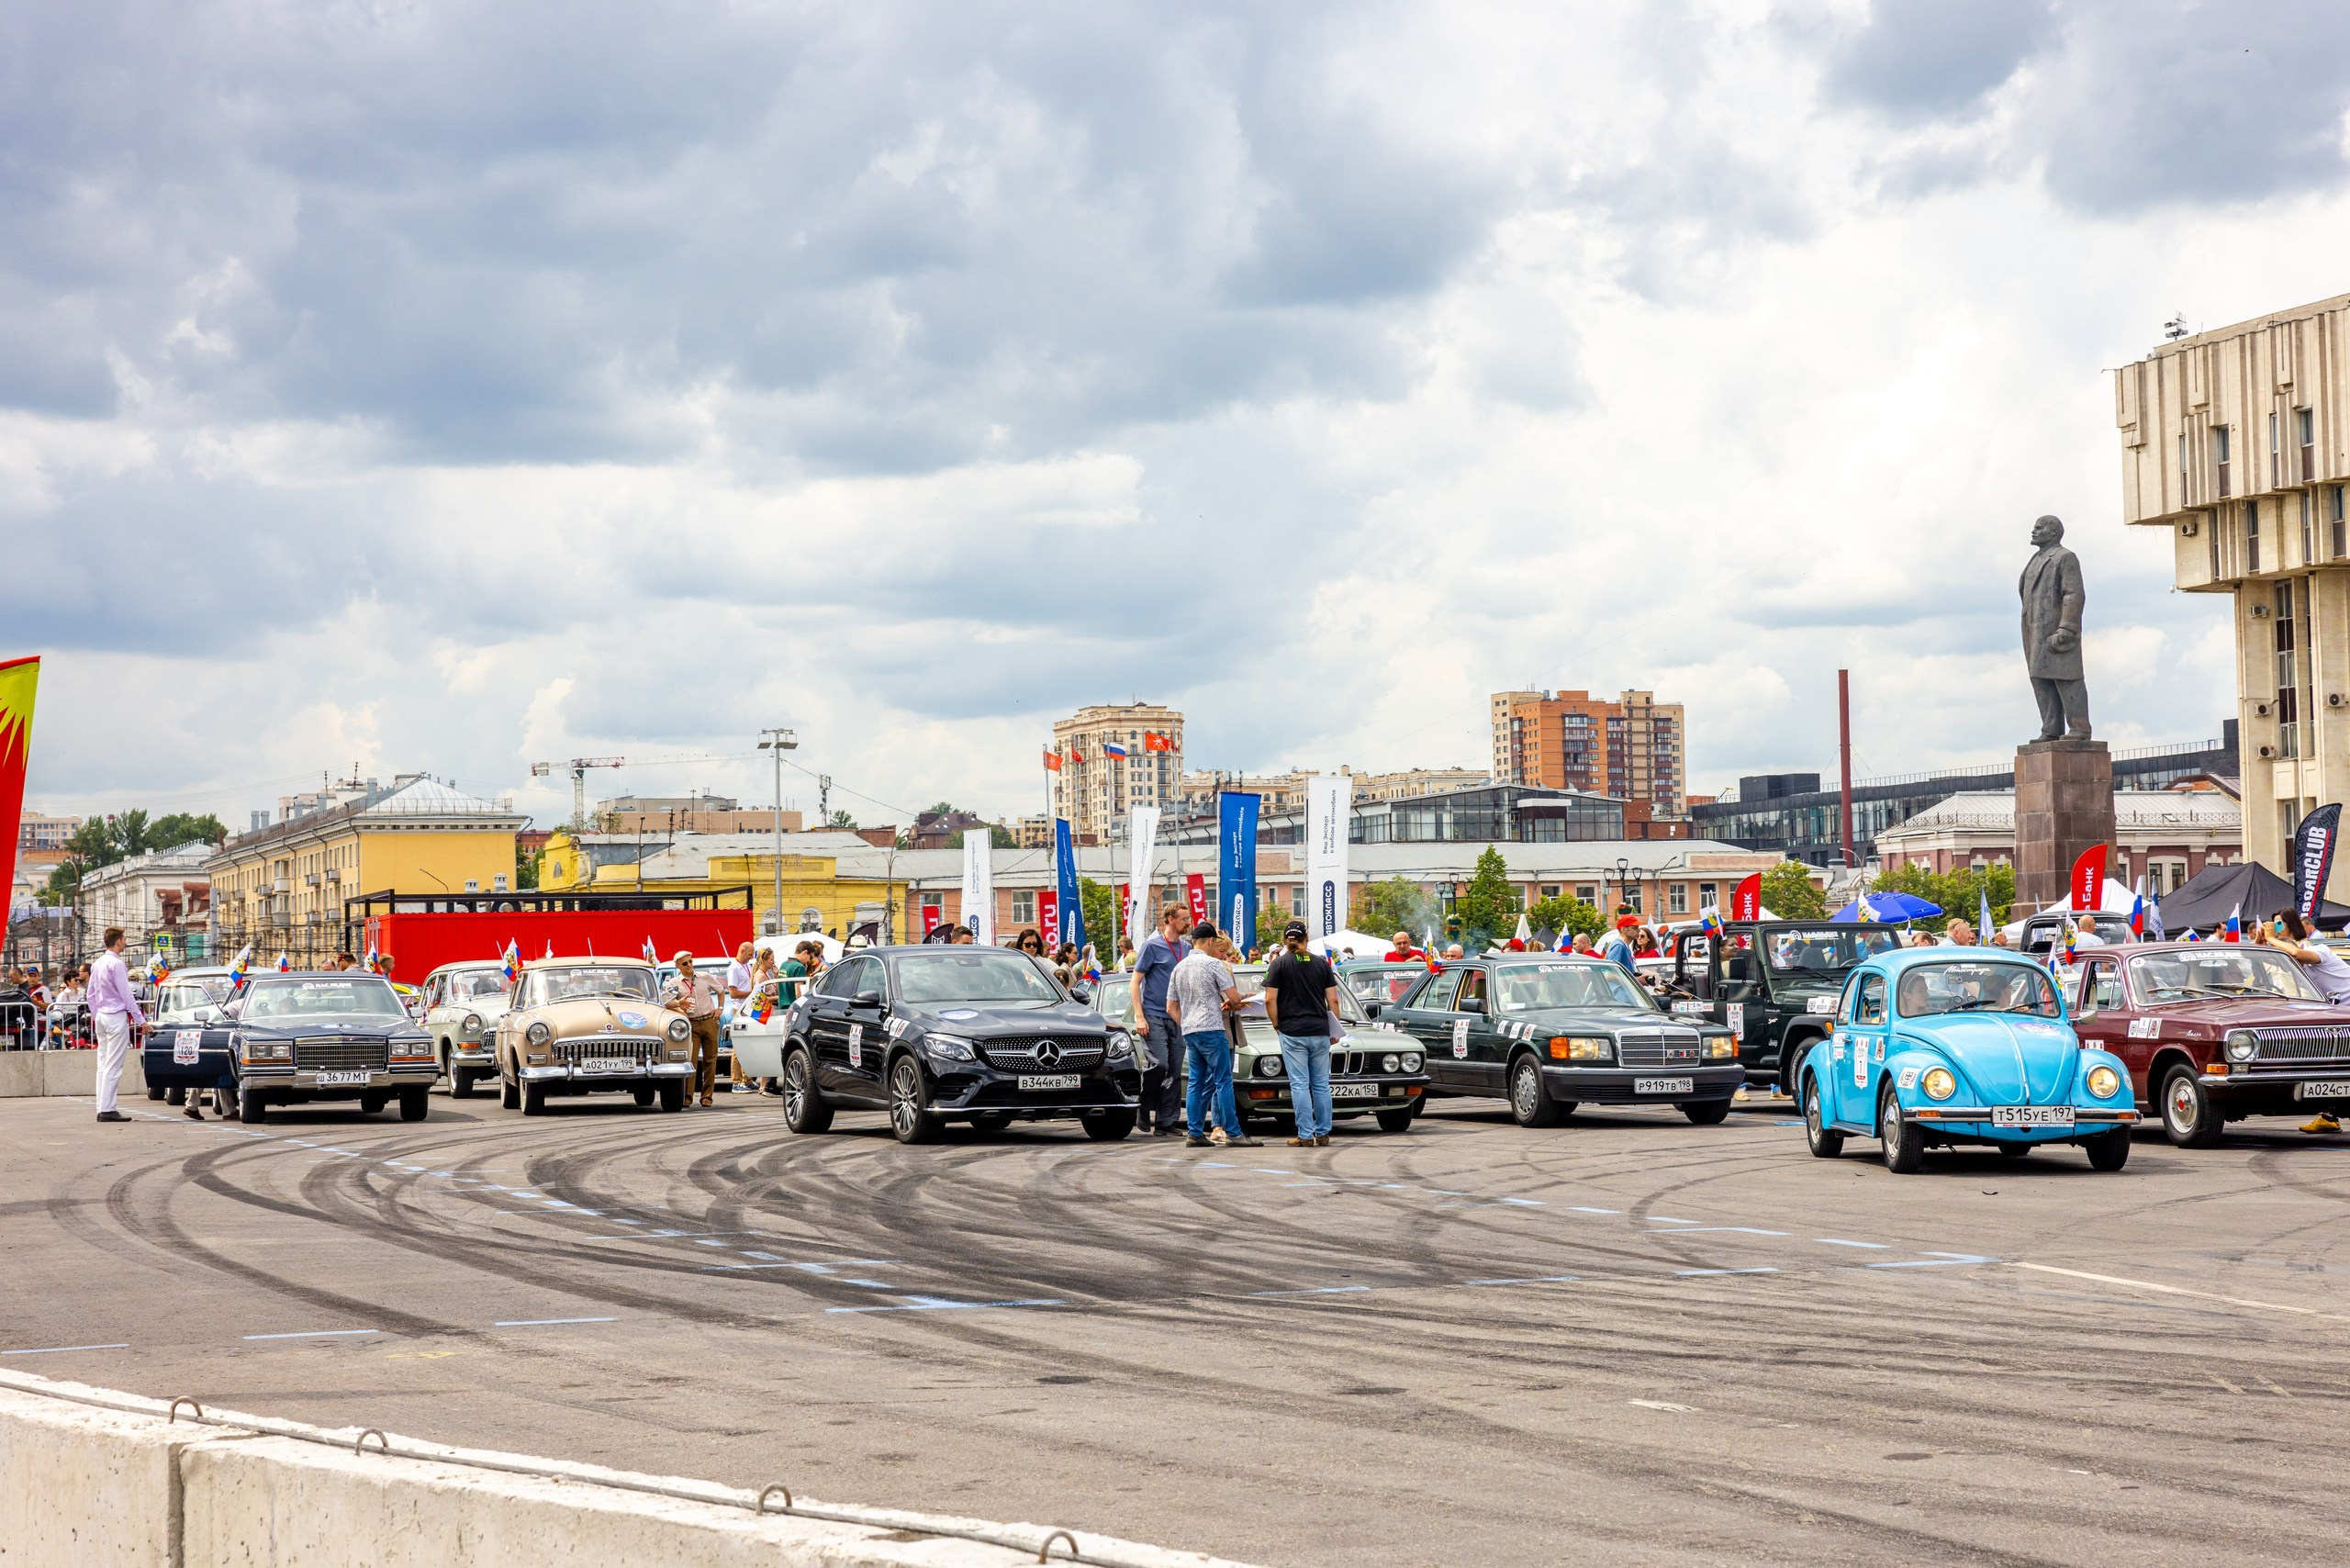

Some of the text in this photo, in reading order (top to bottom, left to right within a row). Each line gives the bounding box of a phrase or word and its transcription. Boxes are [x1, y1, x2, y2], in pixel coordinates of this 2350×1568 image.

[2082, 867, 2094, 902] Банк
[1457, 1036, 1463, 1047] 22
[181, 1047, 193, 1056] 120
[620, 1058, 633, 1067] 199
[1022, 1076, 1078, 1088] В344КВ 799
[1639, 1080, 1691, 1091] Р919ТВ 198
[1330, 1084, 1376, 1097] 222КА 150
[2308, 1083, 2350, 1095] А024СТ
[1998, 1107, 2071, 1122] Т515УЕ 197
